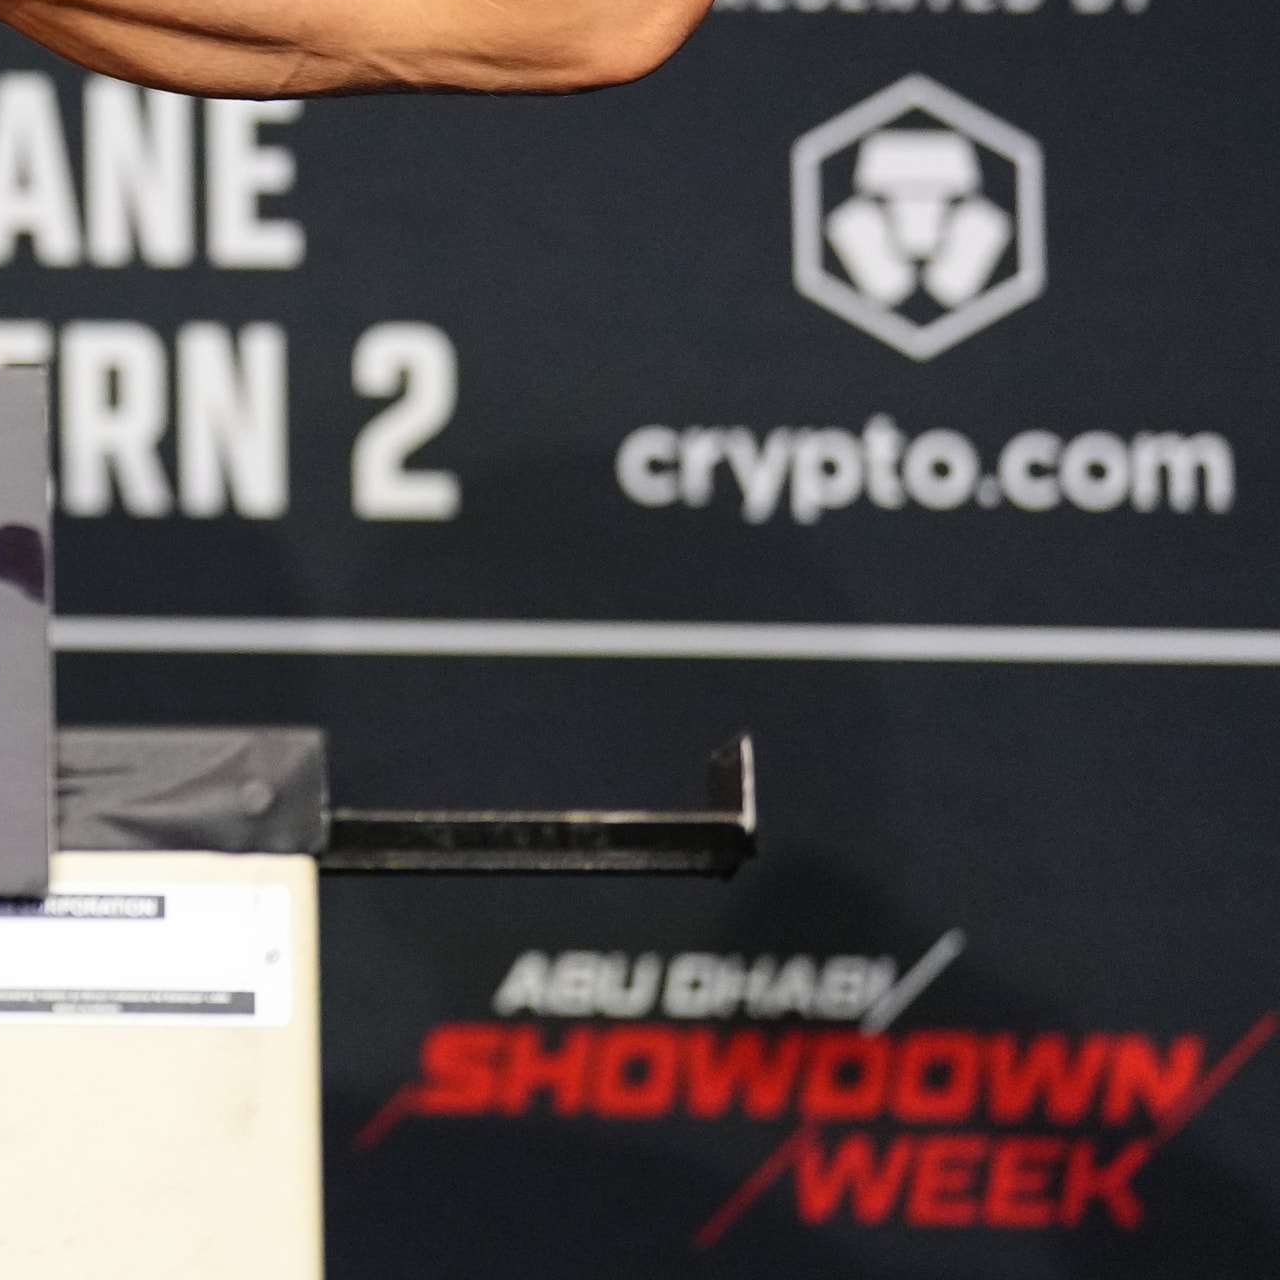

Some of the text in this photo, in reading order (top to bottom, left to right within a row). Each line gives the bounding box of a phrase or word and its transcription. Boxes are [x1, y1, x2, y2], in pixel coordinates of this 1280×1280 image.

[352, 321, 462, 523] 2
[615, 412, 1236, 524] crypto.com
[493, 951, 895, 1020] ABU DHABI
[415, 1023, 1204, 1121] SHOWDOWN
[793, 1131, 1152, 1230] WEEK
